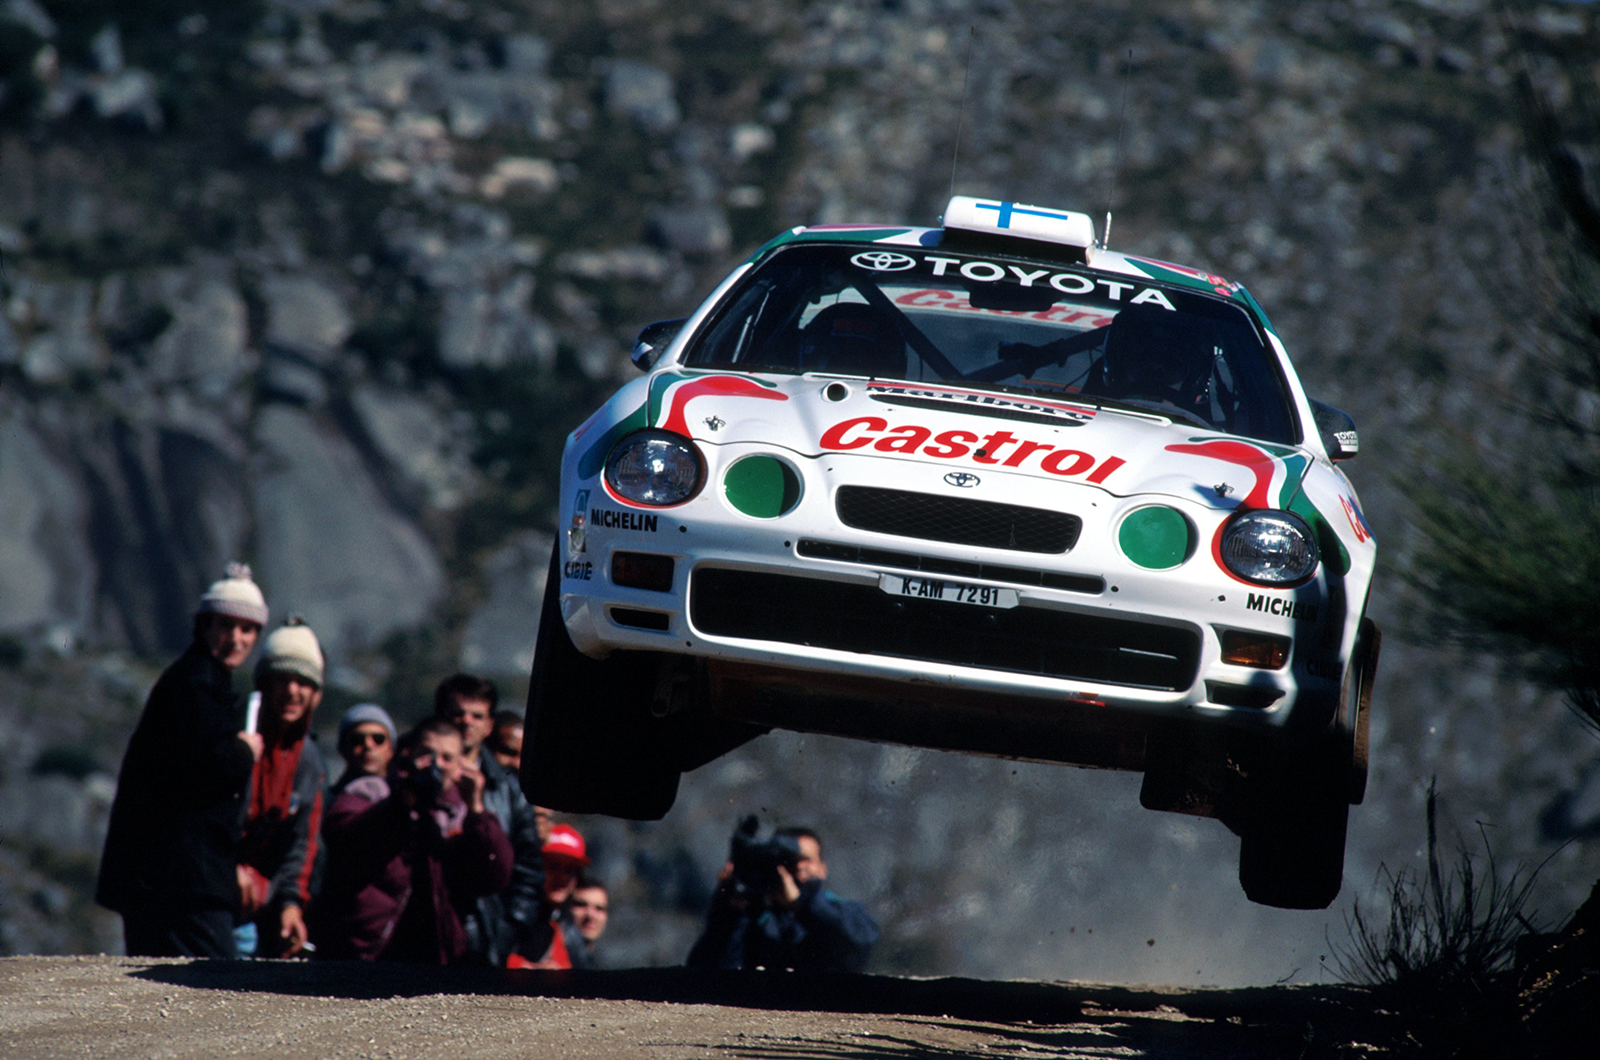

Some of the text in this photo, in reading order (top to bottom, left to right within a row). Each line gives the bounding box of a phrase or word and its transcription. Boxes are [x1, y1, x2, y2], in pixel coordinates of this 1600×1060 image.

[924, 255, 1177, 311] TOYOTA
[819, 415, 1127, 485] Castrol
[590, 508, 658, 532] MICHELIN
[901, 577, 999, 606] K-AM 7291
